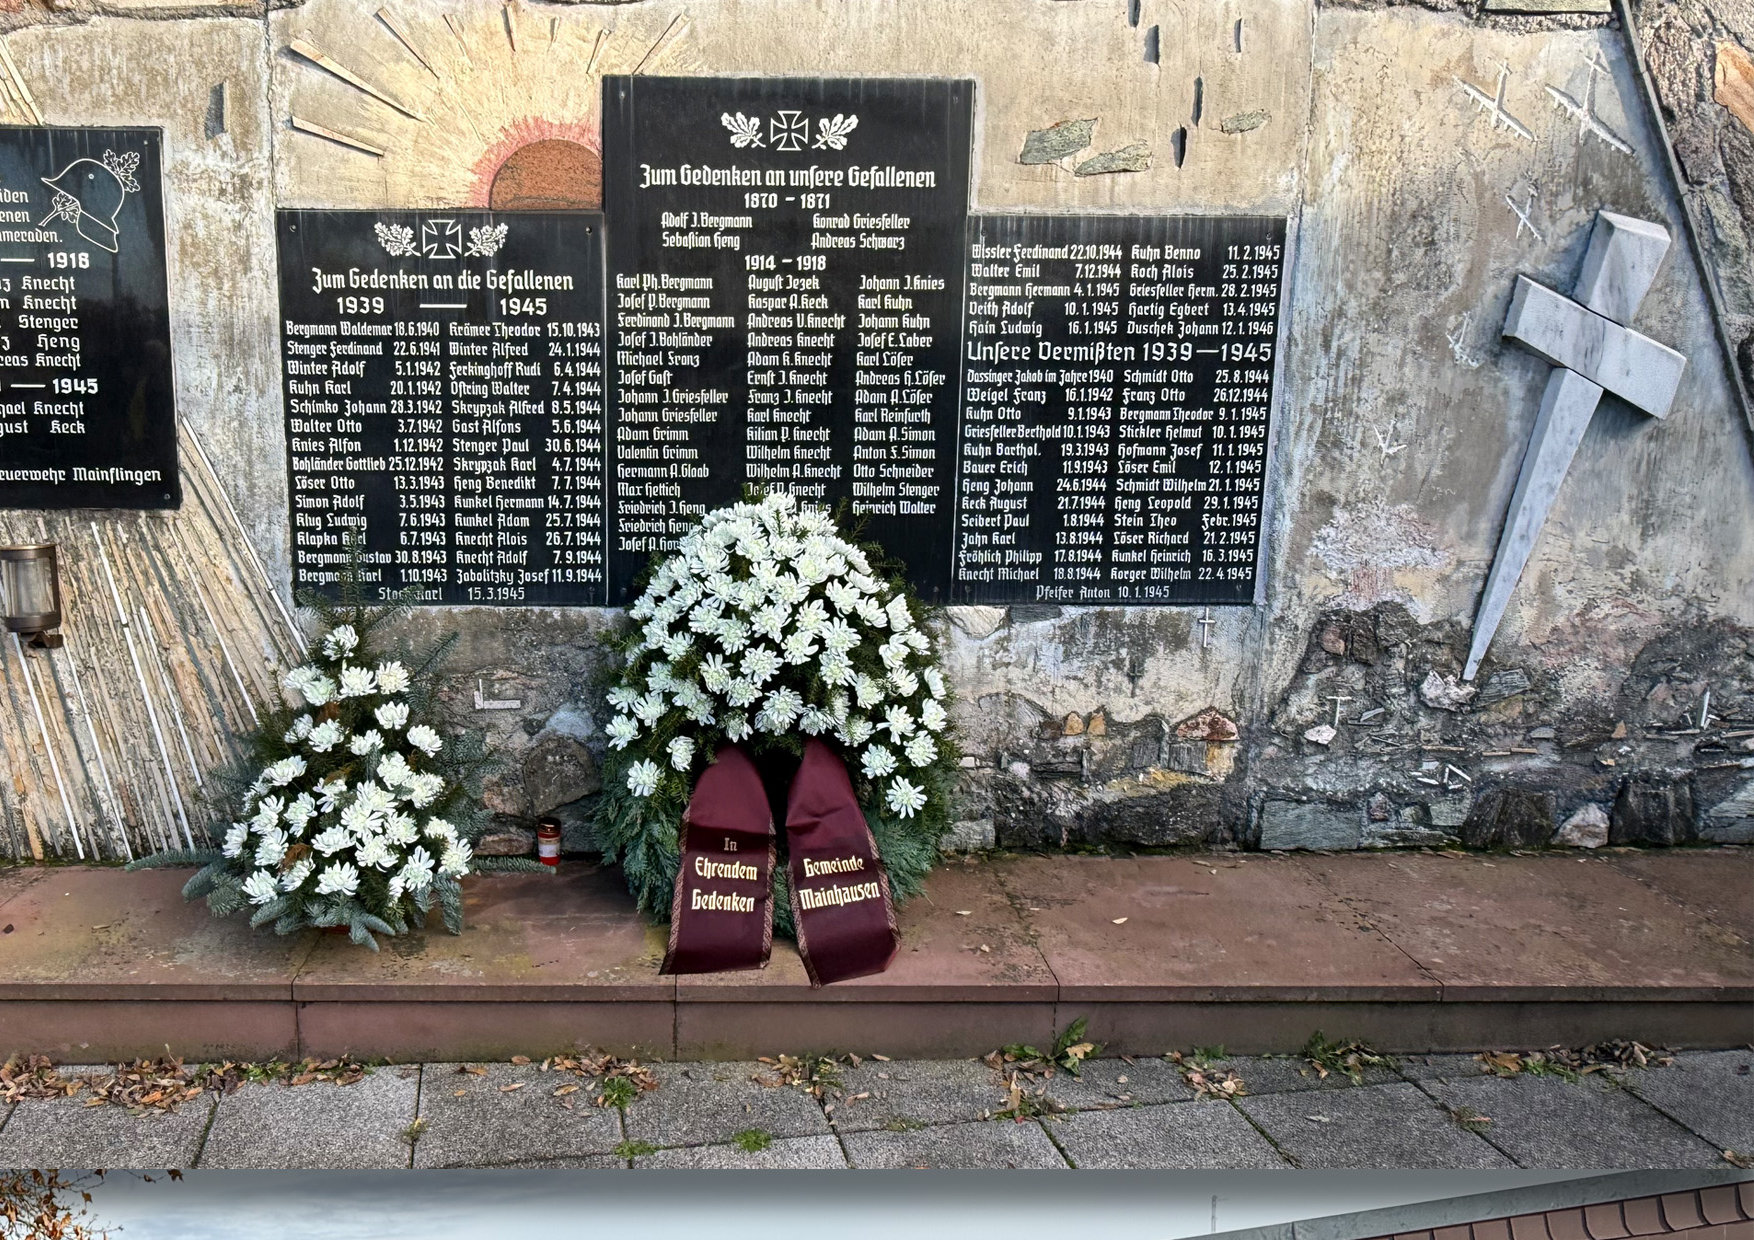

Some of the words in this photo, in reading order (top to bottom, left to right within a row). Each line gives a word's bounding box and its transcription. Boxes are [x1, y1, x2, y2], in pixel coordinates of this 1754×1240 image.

[640, 164, 677, 188] Zum
[680, 164, 762, 186] Gedenken
[765, 168, 786, 185] an
[848, 167, 935, 189] Gefallenen
[744, 193, 777, 208] 1870
[800, 194, 830, 208] 1871
[813, 215, 850, 229] Konrad
[853, 216, 910, 231] Griesfeller
[811, 234, 855, 249] Andreas
[859, 234, 905, 249] Schwarz
[47, 252, 89, 269] 1918
[745, 256, 775, 270] 1914
[796, 256, 826, 271] 1918
[972, 265, 1009, 278] Walter
[1016, 265, 1039, 277] Emil
[22, 276, 75, 291] Knecht
[312, 267, 345, 293] Zum
[349, 269, 428, 290] Gedenken
[433, 273, 453, 288] an
[458, 270, 480, 289] die
[487, 270, 573, 293] Gefallenen
[23, 296, 76, 311] Knecht
[337, 297, 384, 314] 1939
[500, 298, 547, 315] 1945
[858, 295, 881, 309] Karl
[19, 315, 78, 332] Stenger
[286, 321, 337, 338] Bergmann
[341, 322, 392, 336] Waldemar
[395, 322, 439, 336] 18.6.1940
[449, 342, 488, 355] Winter
[492, 342, 528, 357] Alfred
[35, 353, 81, 370] Knecht
[1124, 370, 1167, 384] Schmidt
[1171, 371, 1193, 383] Otto
[53, 378, 98, 394] 1945
[325, 381, 351, 395] Karl
[34, 401, 84, 417] Knecht
[617, 427, 649, 442] Adam
[653, 428, 688, 441] Grimm
[73, 467, 161, 484] Mainflingen
[853, 465, 874, 478] Otto
[879, 465, 934, 479] Schneider
[296, 496, 329, 508] Simon
[333, 495, 364, 510] Adolf
[1150, 568, 1191, 580] Wilhelm
[724, 837, 737, 851] In
[695, 857, 757, 881] Ehrendem
[803, 856, 864, 877] Gemeinde
[691, 889, 754, 912] Gedenken
[799, 882, 880, 909] Mainhausen
